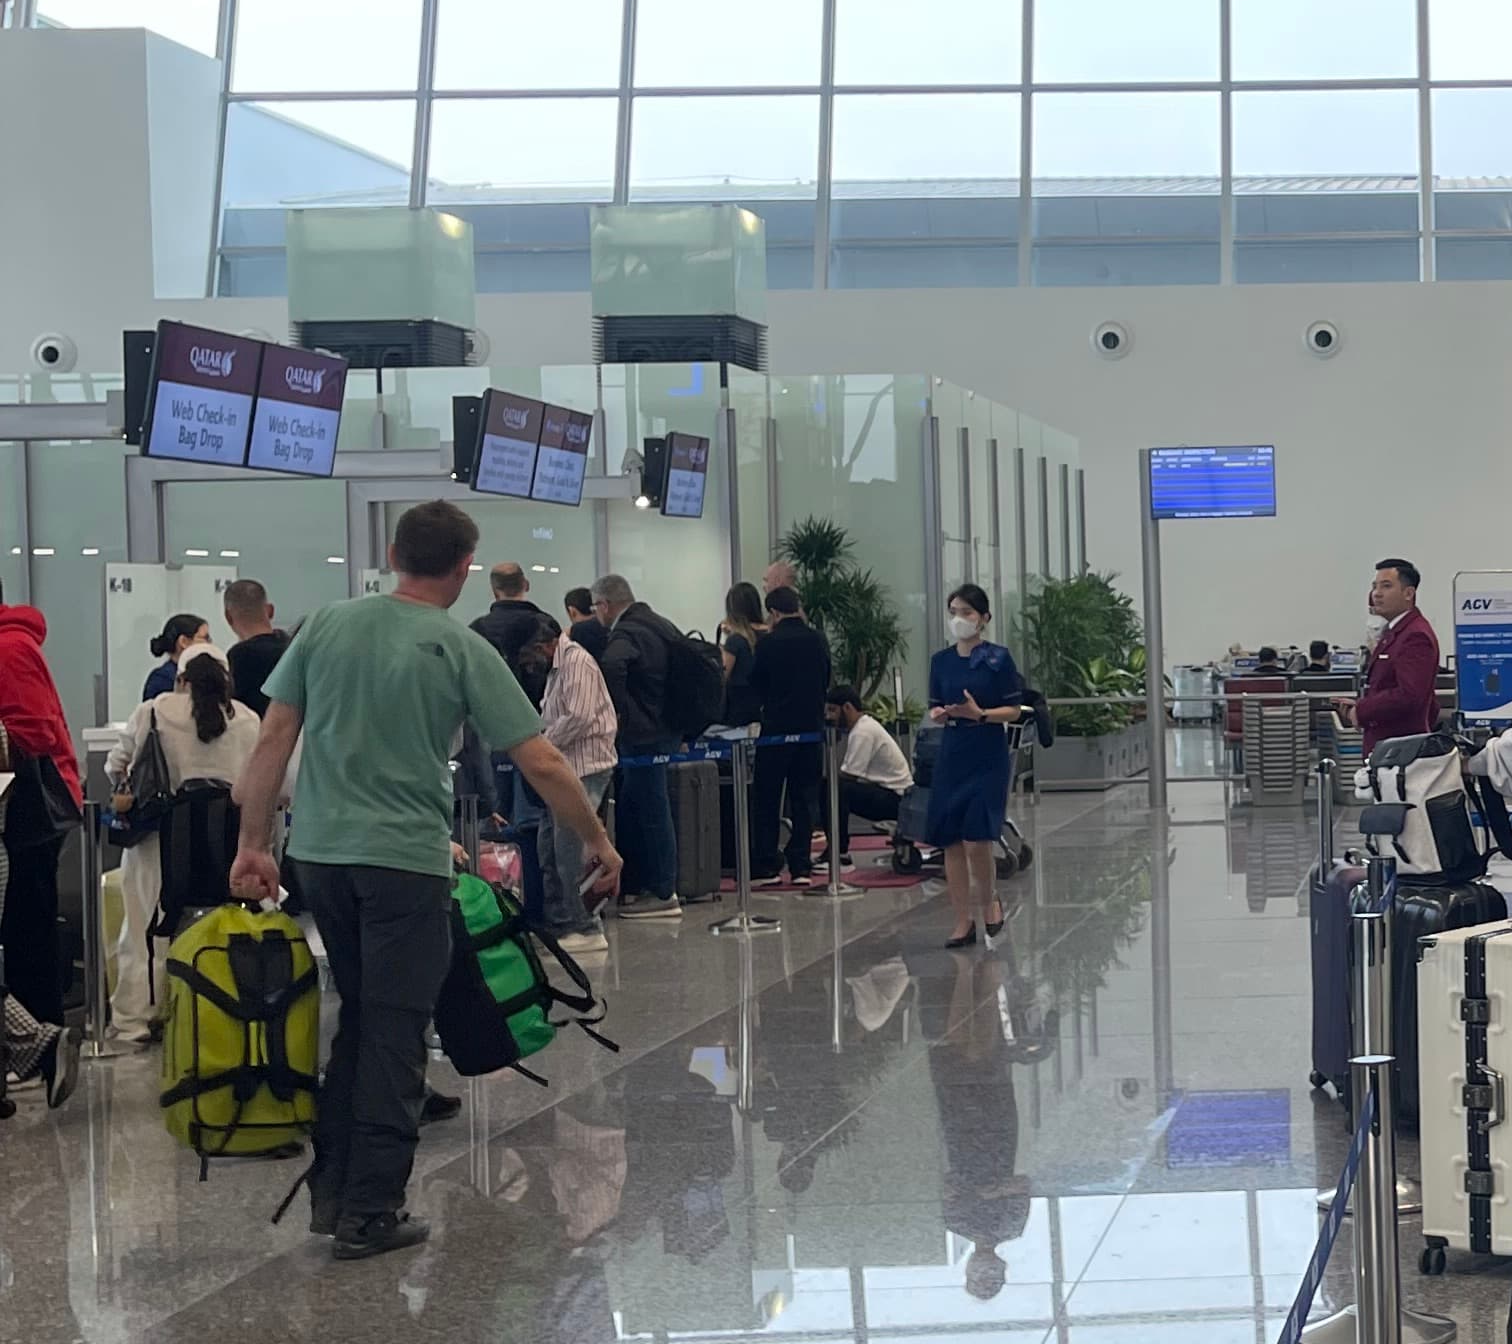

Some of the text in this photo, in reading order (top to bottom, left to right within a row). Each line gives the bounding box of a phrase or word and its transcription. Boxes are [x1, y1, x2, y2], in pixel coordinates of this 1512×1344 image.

[190, 346, 222, 370] QATAR
[286, 366, 314, 387] QATAR
[171, 399, 237, 427] Web Check-in
[178, 426, 223, 453] Bag Drop
[268, 415, 326, 440] Web Check-in
[273, 438, 313, 463] Bag Drop
[1462, 598, 1493, 611] ACV
